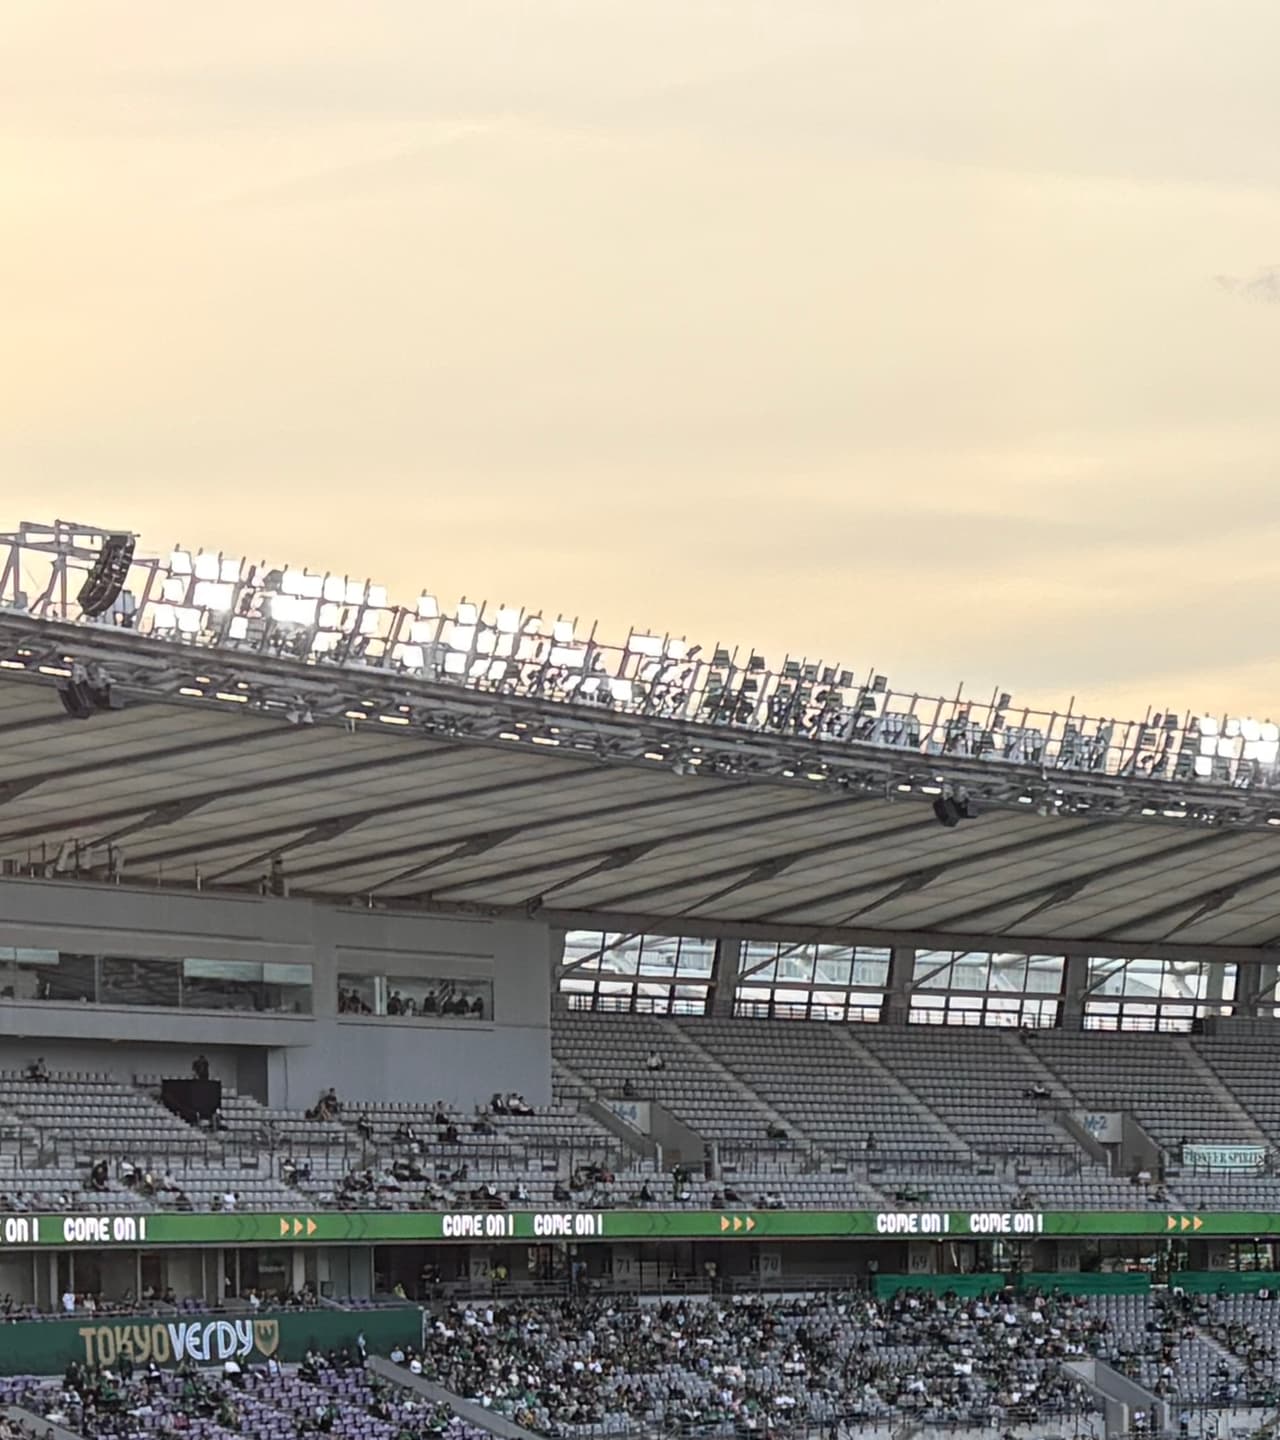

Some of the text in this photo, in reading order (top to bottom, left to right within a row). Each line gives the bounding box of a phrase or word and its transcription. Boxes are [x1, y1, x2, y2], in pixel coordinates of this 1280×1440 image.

[5, 1218, 28, 1242] ON
[64, 1217, 110, 1241] COME
[443, 1215, 483, 1236] COME
[534, 1214, 572, 1235] COME
[877, 1213, 918, 1233] COME
[970, 1213, 1011, 1233] COME
